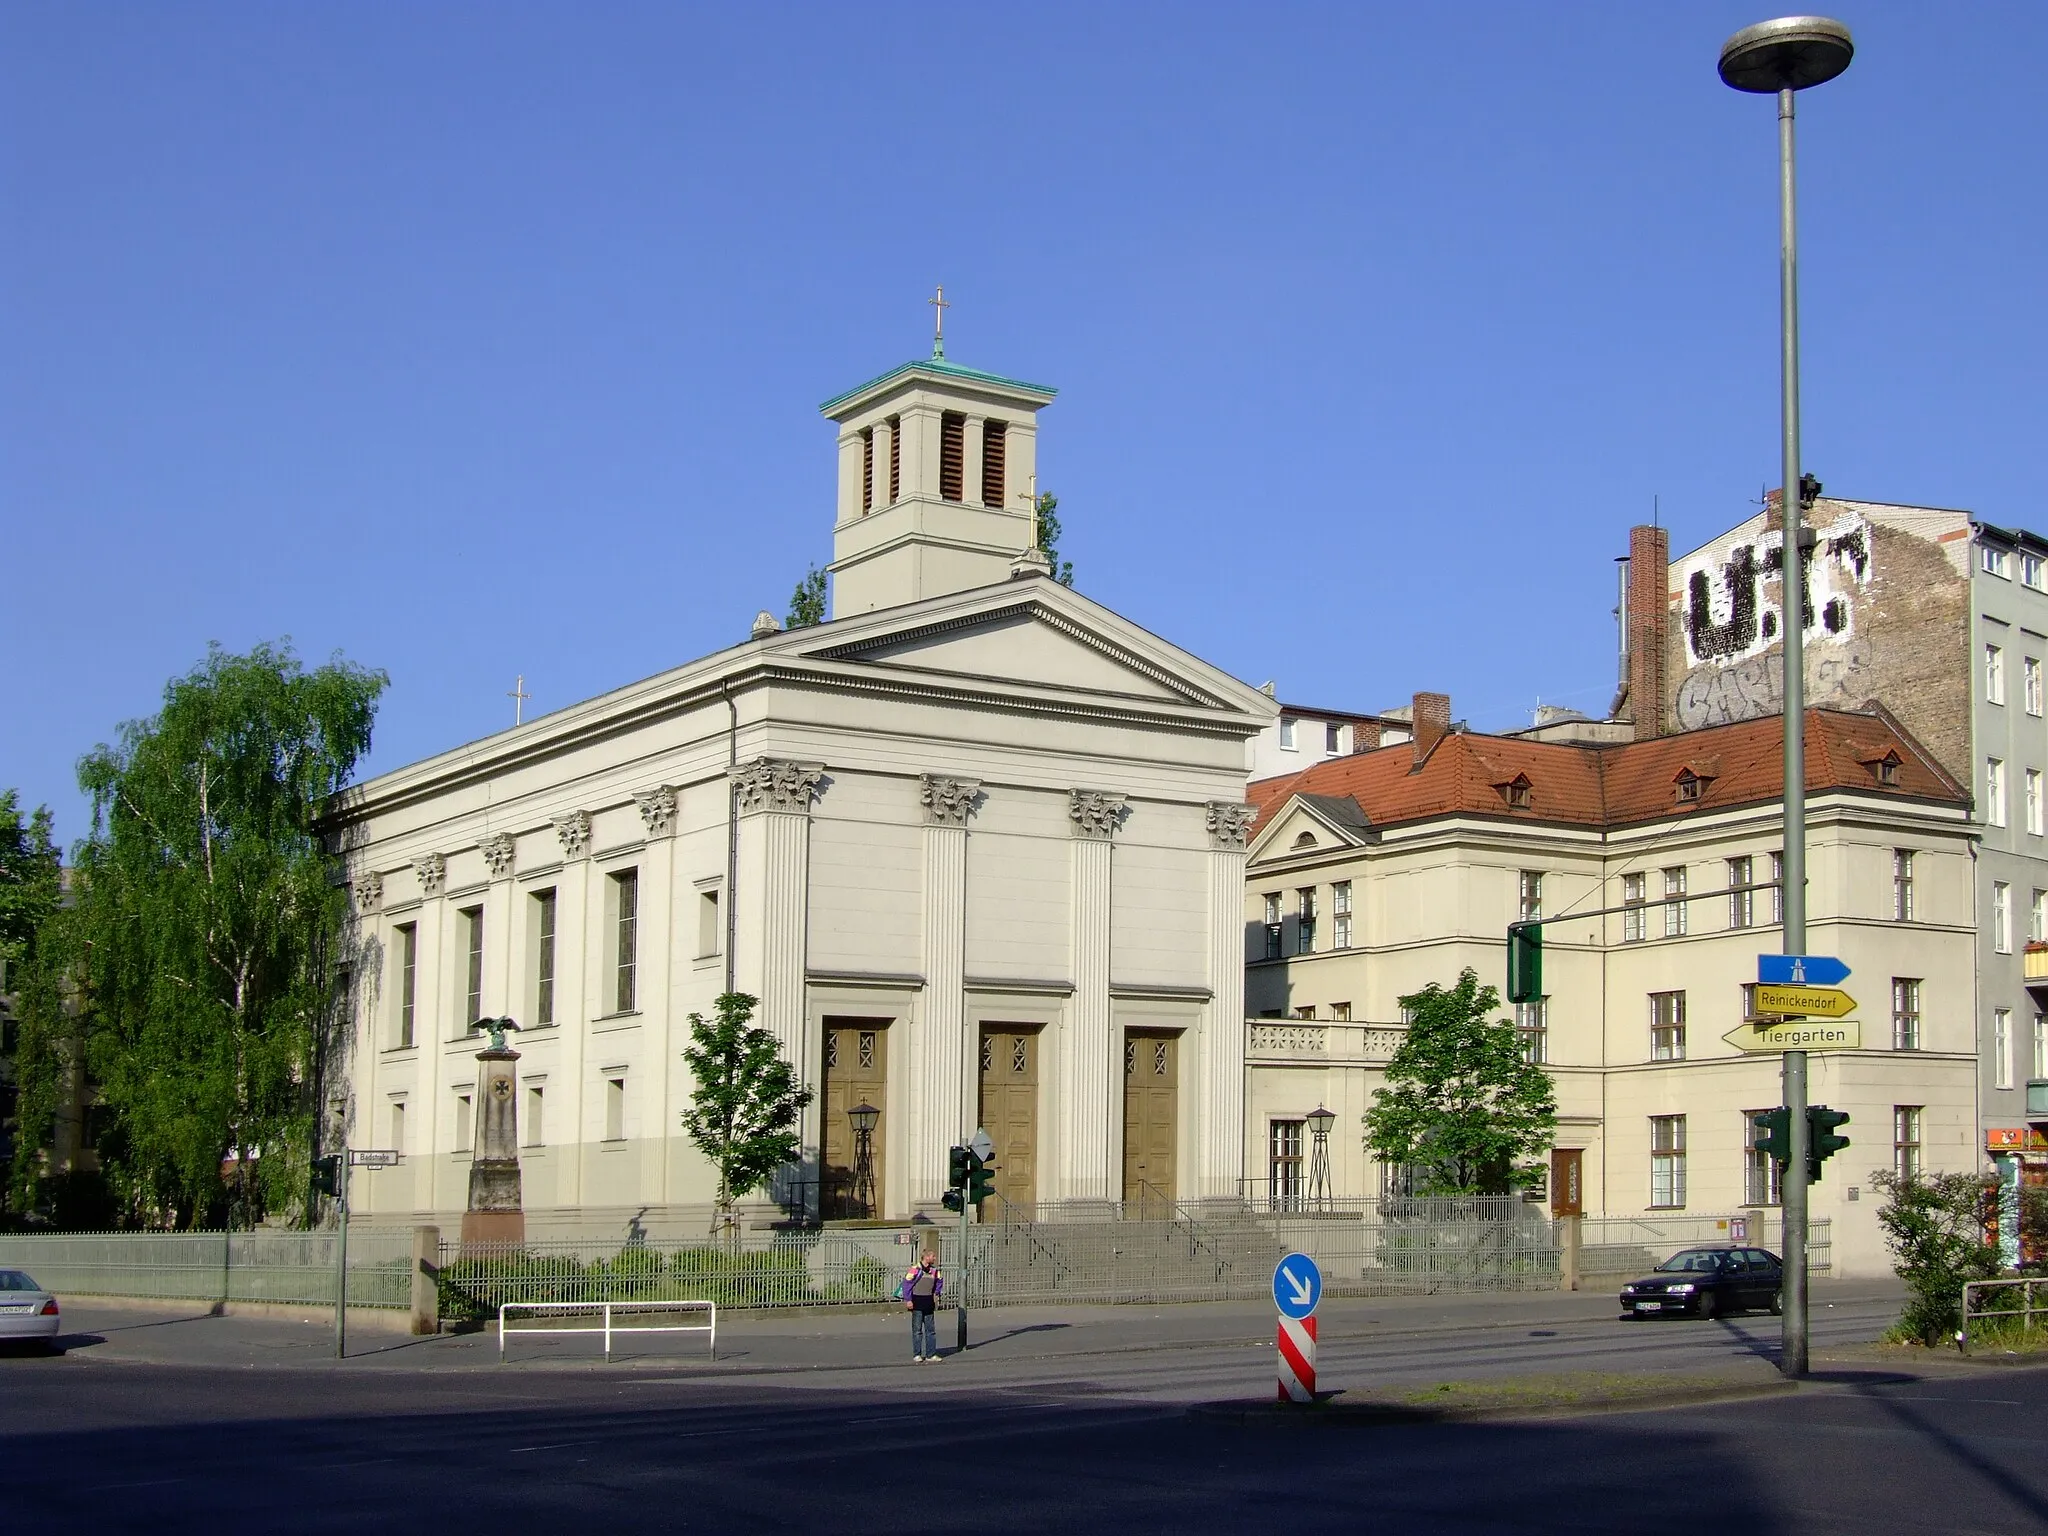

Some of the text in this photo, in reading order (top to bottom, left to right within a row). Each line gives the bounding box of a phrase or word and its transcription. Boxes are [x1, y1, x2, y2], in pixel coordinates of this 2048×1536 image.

[1761, 992, 1836, 1009] Reinickendorf
[1760, 1028, 1845, 1045] Tiergarten
[360, 1153, 390, 1162] Badstraße
